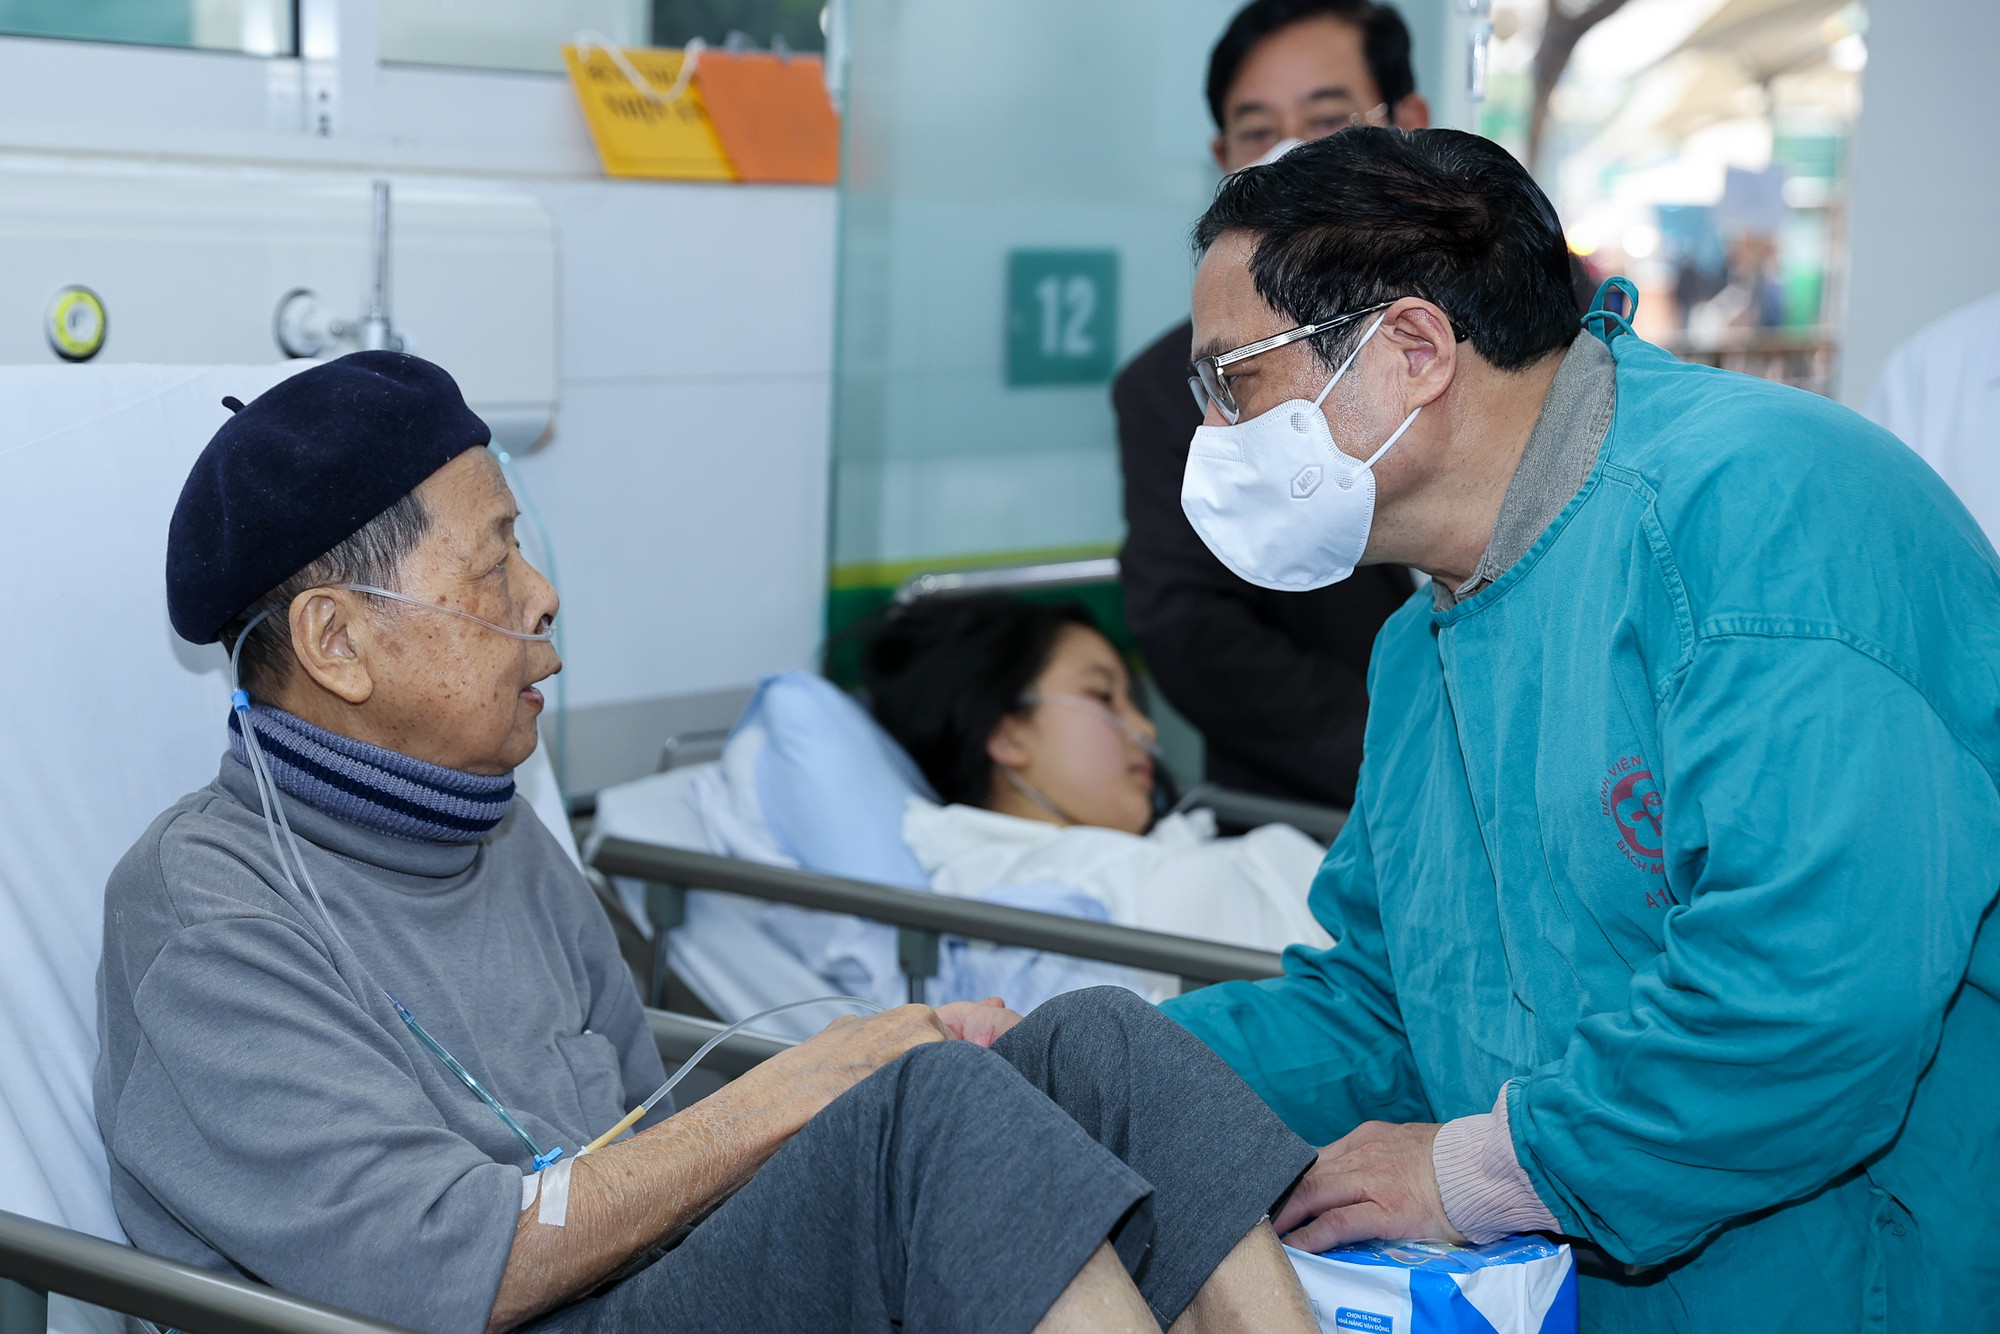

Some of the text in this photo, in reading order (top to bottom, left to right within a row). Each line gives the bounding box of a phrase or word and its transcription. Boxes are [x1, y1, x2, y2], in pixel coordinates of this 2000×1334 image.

[1036, 274, 1097, 356] 12
[1607, 755, 1643, 776] VIỆN
[1651, 862, 1664, 874] M
[1645, 888, 1670, 908] A1
